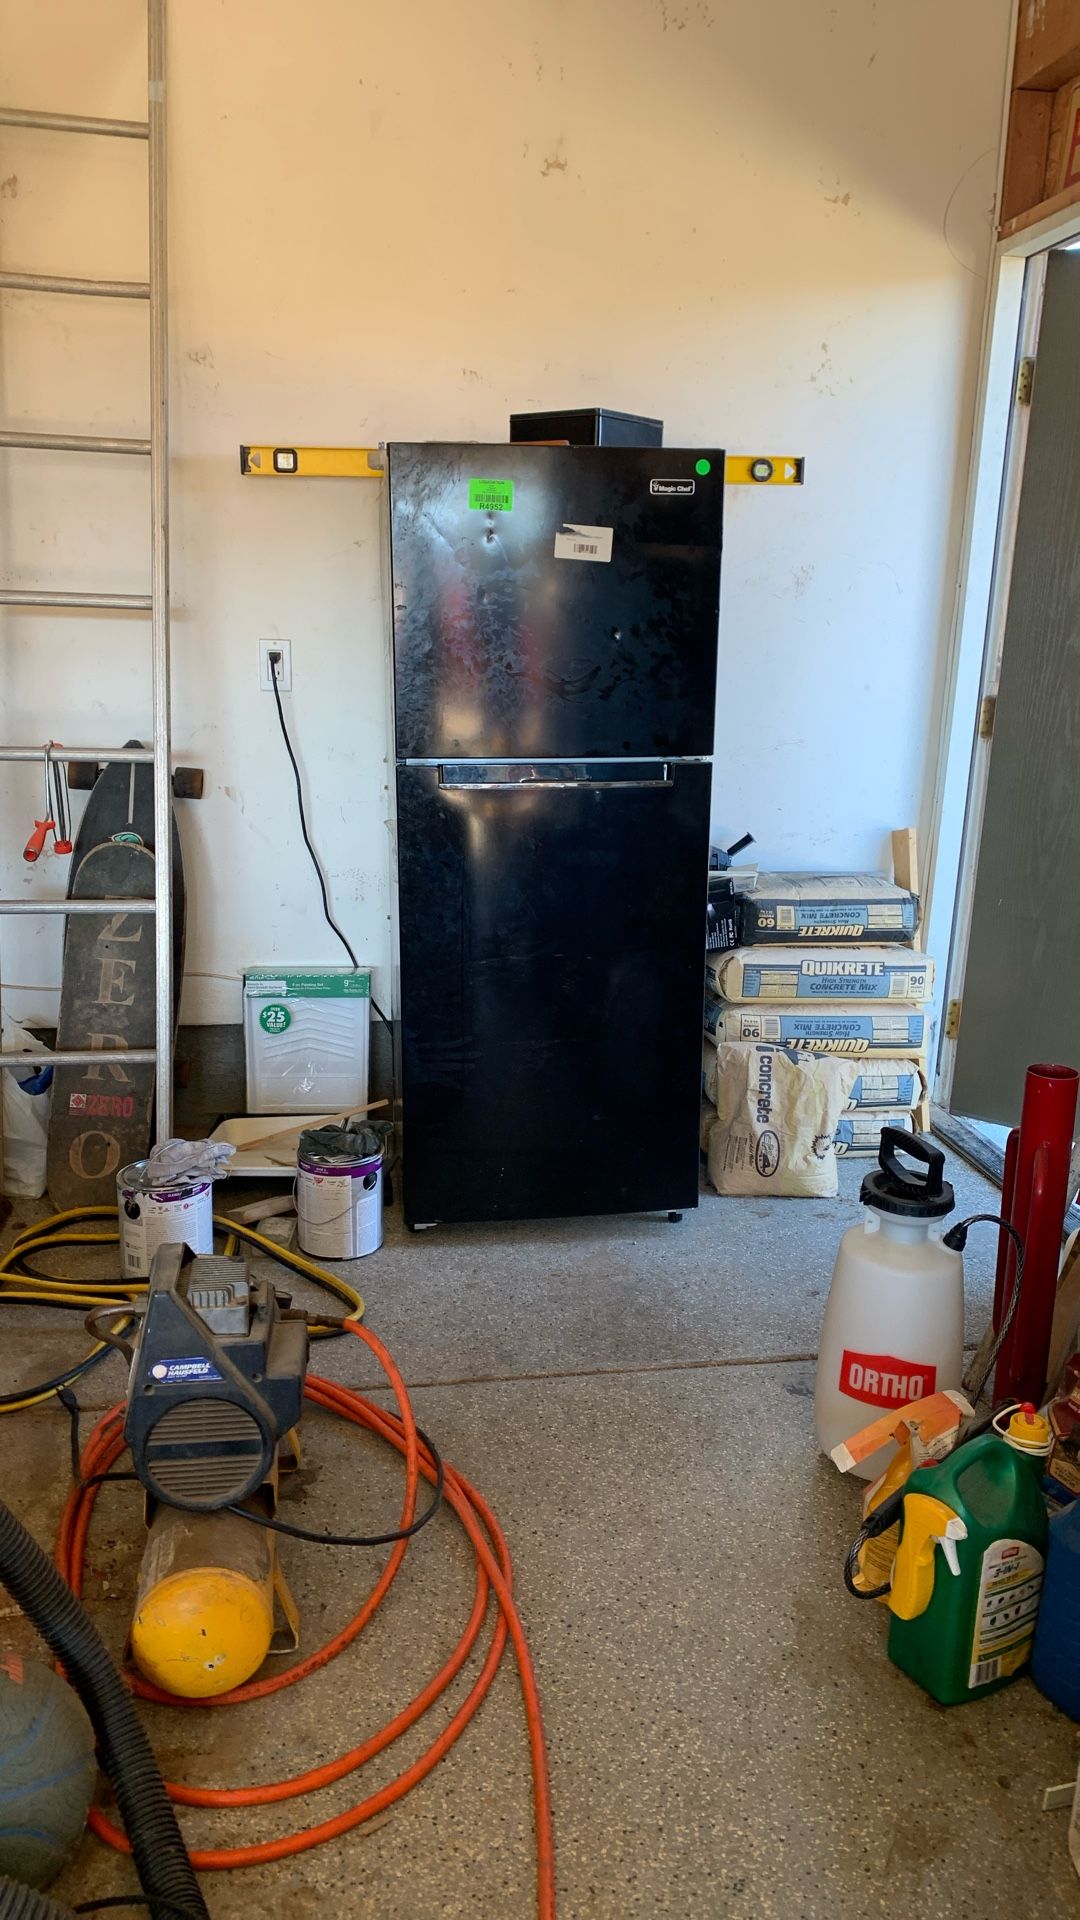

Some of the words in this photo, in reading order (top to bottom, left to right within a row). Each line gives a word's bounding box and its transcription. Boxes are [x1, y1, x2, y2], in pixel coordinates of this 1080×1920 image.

[479, 502, 504, 511] R4952
[757, 918, 775, 928] 60
[798, 924, 866, 937] QUIKRETE
[801, 960, 885, 976] QUIKRETE
[910, 976, 925, 985] 90
[262, 1011, 286, 1023] $25
[742, 1028, 760, 1038] 90
[786, 1038, 870, 1053] QUIKRETE
[756, 1055, 773, 1124] concrete
[86, 1095, 134, 1117] ZERO
[167, 1368, 209, 1377] HAUSFELD
[169, 1362, 211, 1371] CAMPBELL
[849, 1362, 924, 1401] ORTHO
